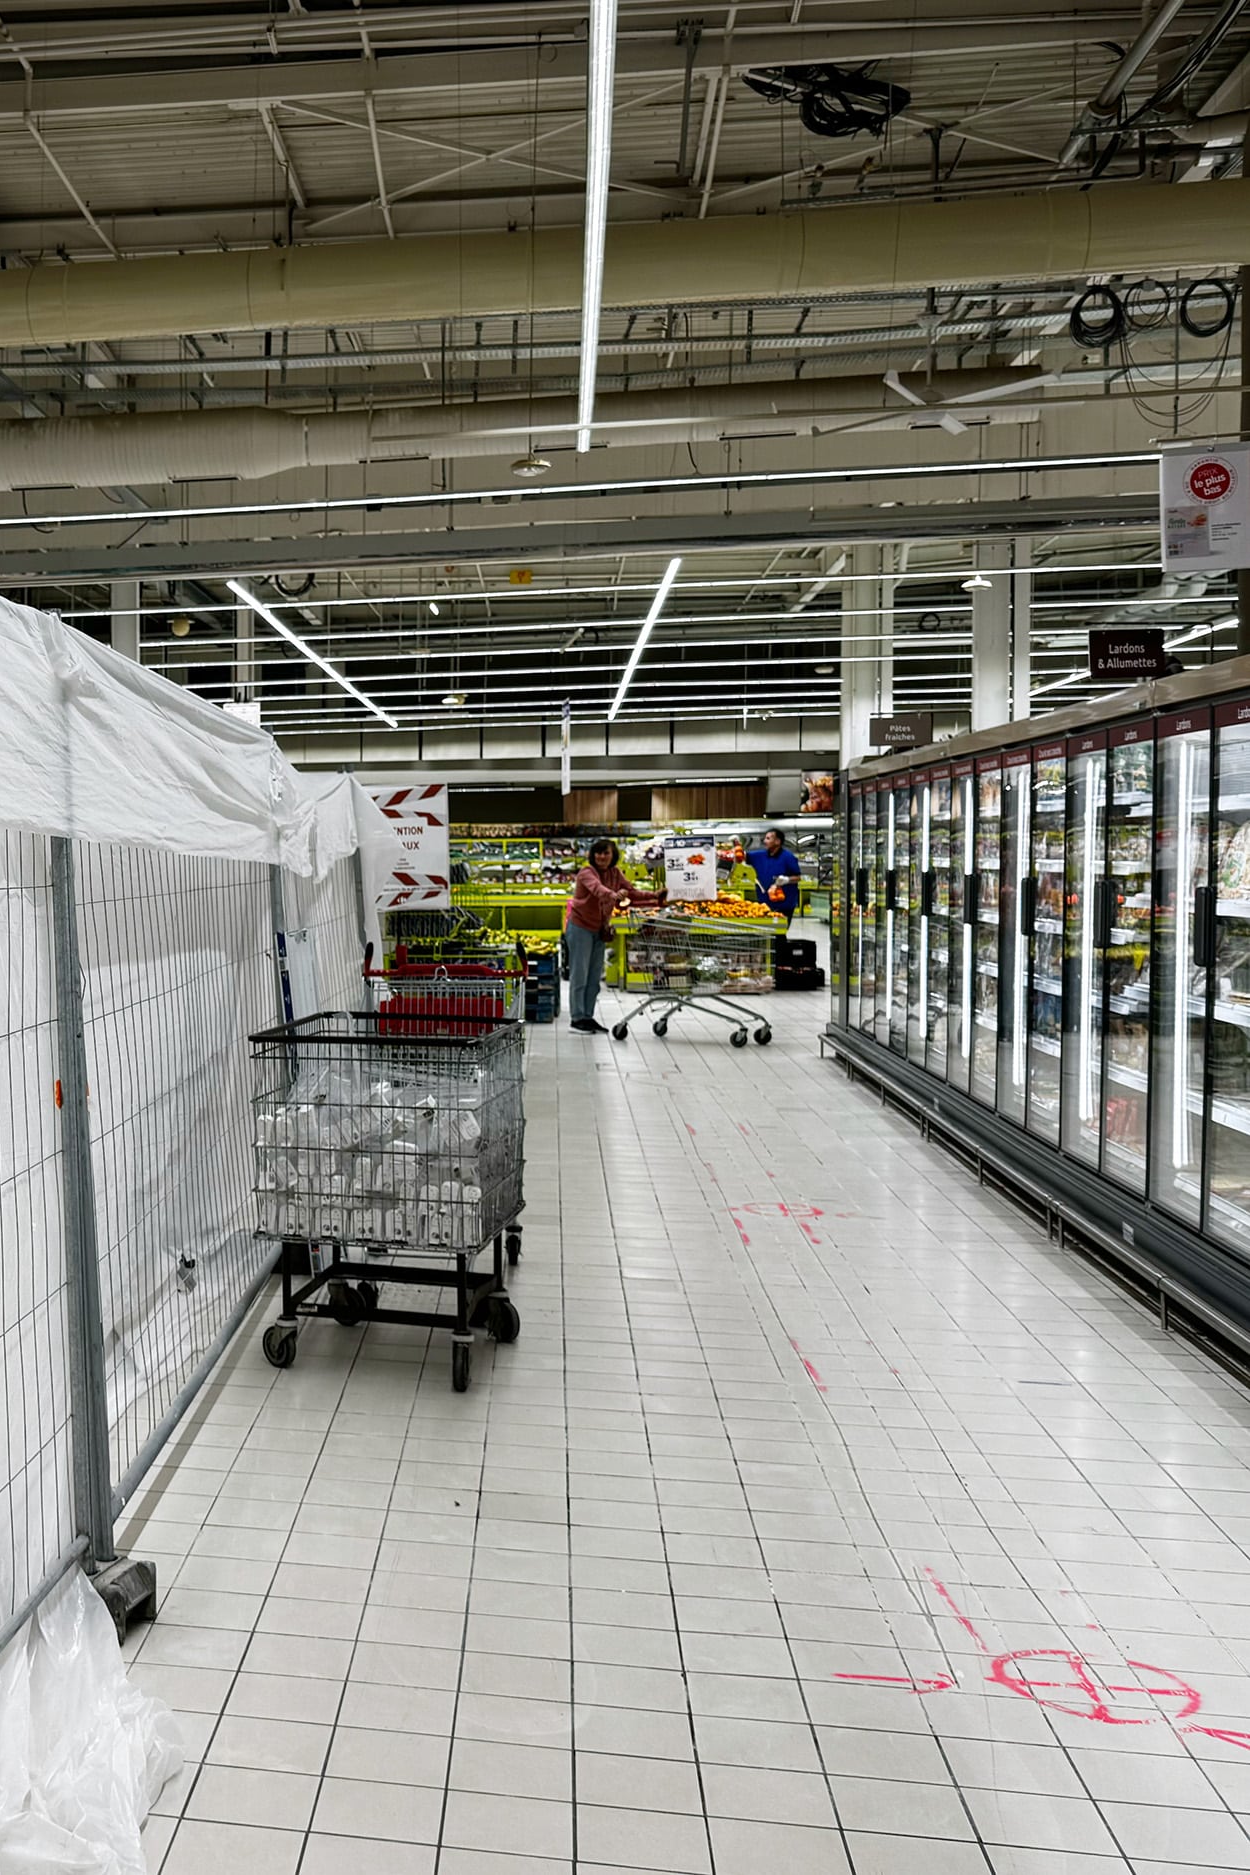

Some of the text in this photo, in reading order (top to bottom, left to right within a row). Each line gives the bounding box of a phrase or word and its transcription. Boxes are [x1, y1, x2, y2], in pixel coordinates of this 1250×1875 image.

[1198, 467, 1219, 479] PRIX
[1193, 480, 1204, 489] le
[1205, 474, 1226, 488] plus
[1203, 485, 1223, 496] bas
[1108, 643, 1146, 654] Lardons
[1097, 657, 1158, 669] & Allumettes
[393, 827, 423, 835] NTION
